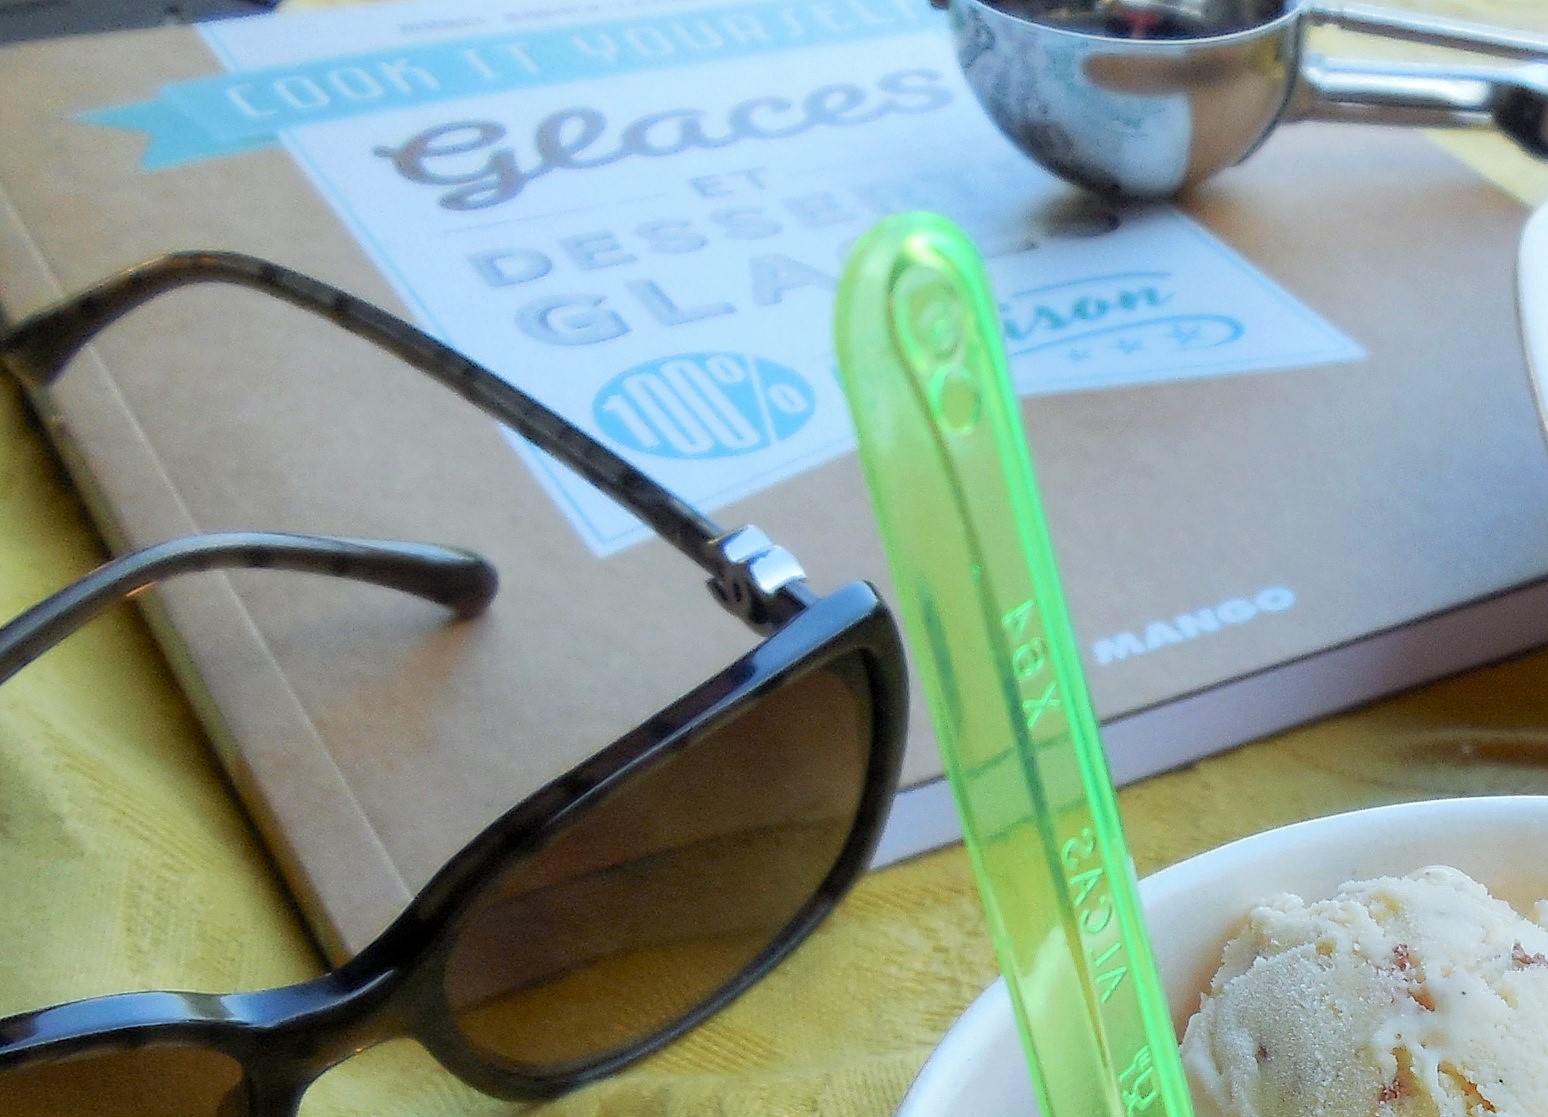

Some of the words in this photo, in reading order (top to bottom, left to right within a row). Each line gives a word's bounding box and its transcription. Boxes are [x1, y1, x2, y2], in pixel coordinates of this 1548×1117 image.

[226, 59, 441, 118] COOK
[458, 44, 543, 80] IT
[373, 68, 954, 212] Glaces
[688, 166, 768, 198] ET
[513, 253, 842, 346] GLA
[999, 284, 1177, 341] ison
[601, 353, 808, 454] 100%
[1091, 583, 1297, 665] MANGO
